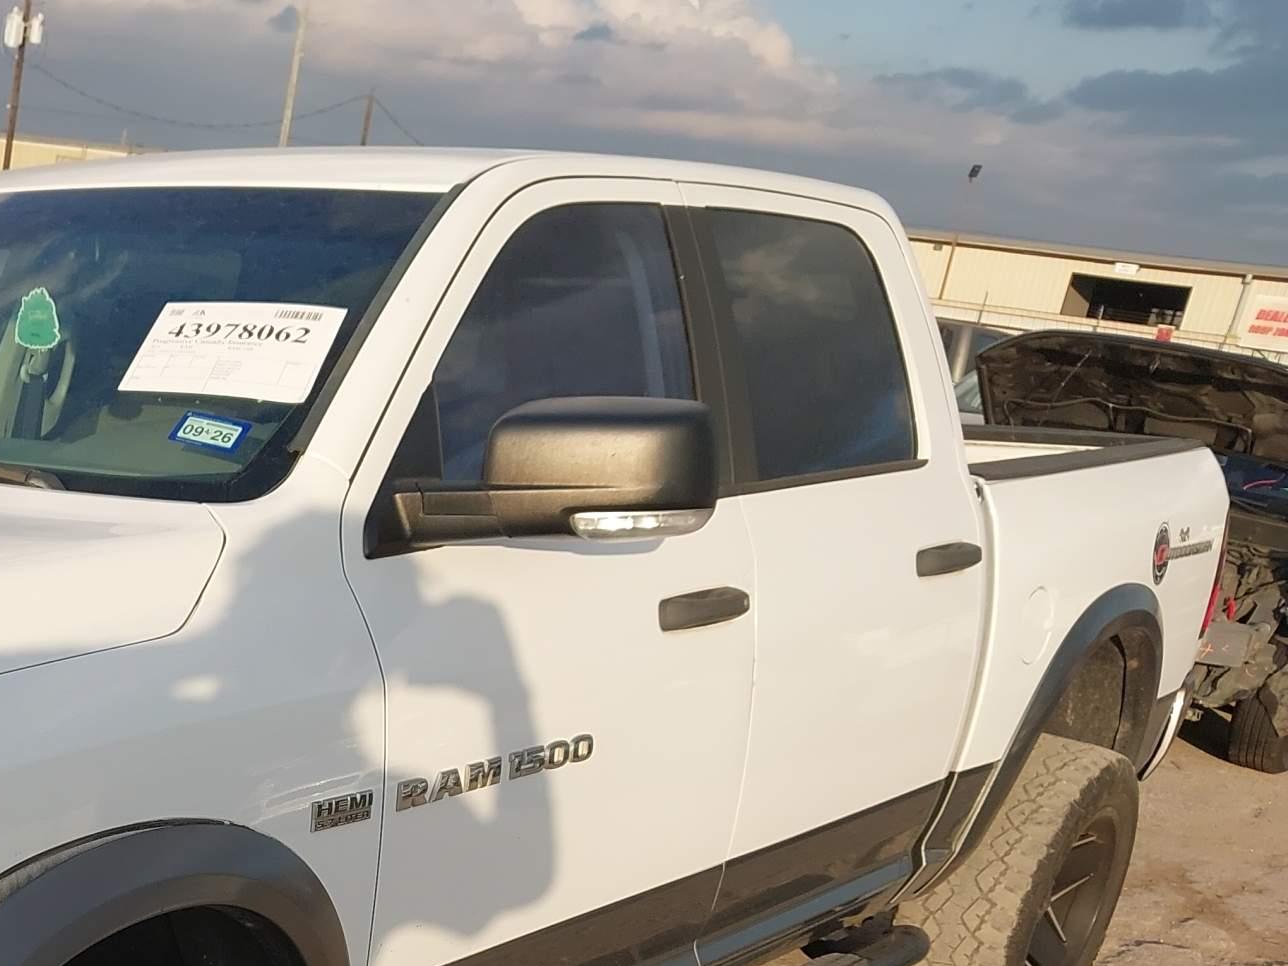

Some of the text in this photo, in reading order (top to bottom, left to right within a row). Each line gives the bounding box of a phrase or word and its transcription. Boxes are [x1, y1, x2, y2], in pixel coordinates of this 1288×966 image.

[168, 322, 311, 344] 43978062
[182, 424, 204, 437] 09
[210, 430, 233, 443] 26
[396, 733, 593, 812] RAM 1500
[316, 792, 373, 818] HEMI
